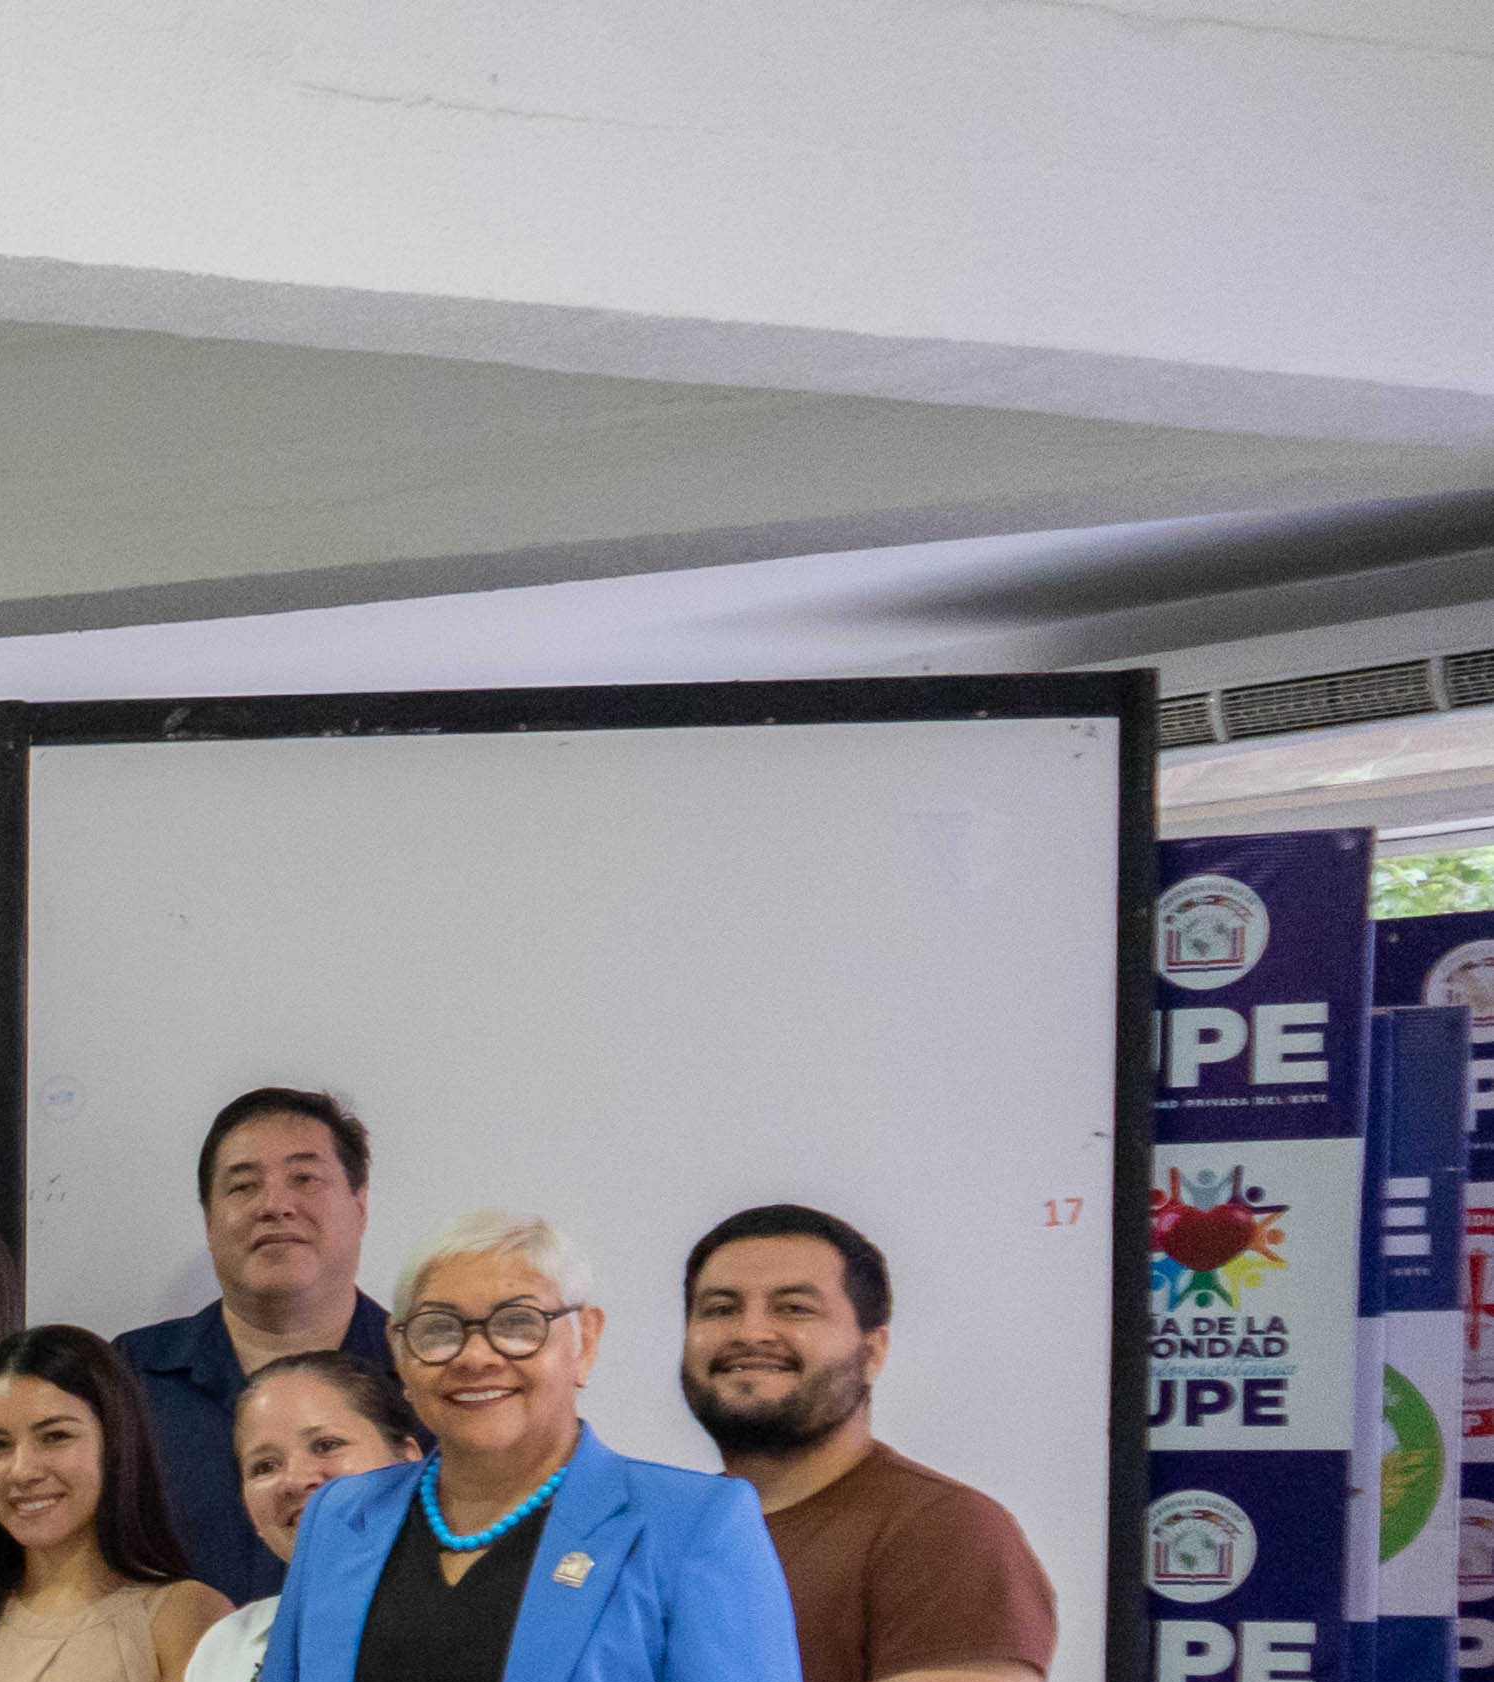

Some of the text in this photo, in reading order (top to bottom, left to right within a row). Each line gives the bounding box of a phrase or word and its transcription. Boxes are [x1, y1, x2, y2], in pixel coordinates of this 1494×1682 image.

[1153, 1002, 1329, 1088] PE
[1043, 1197, 1084, 1228] 17
[1192, 1316, 1237, 1336] DE
[1246, 1315, 1289, 1335] LA
[1150, 1336, 1290, 1360] ONDAD
